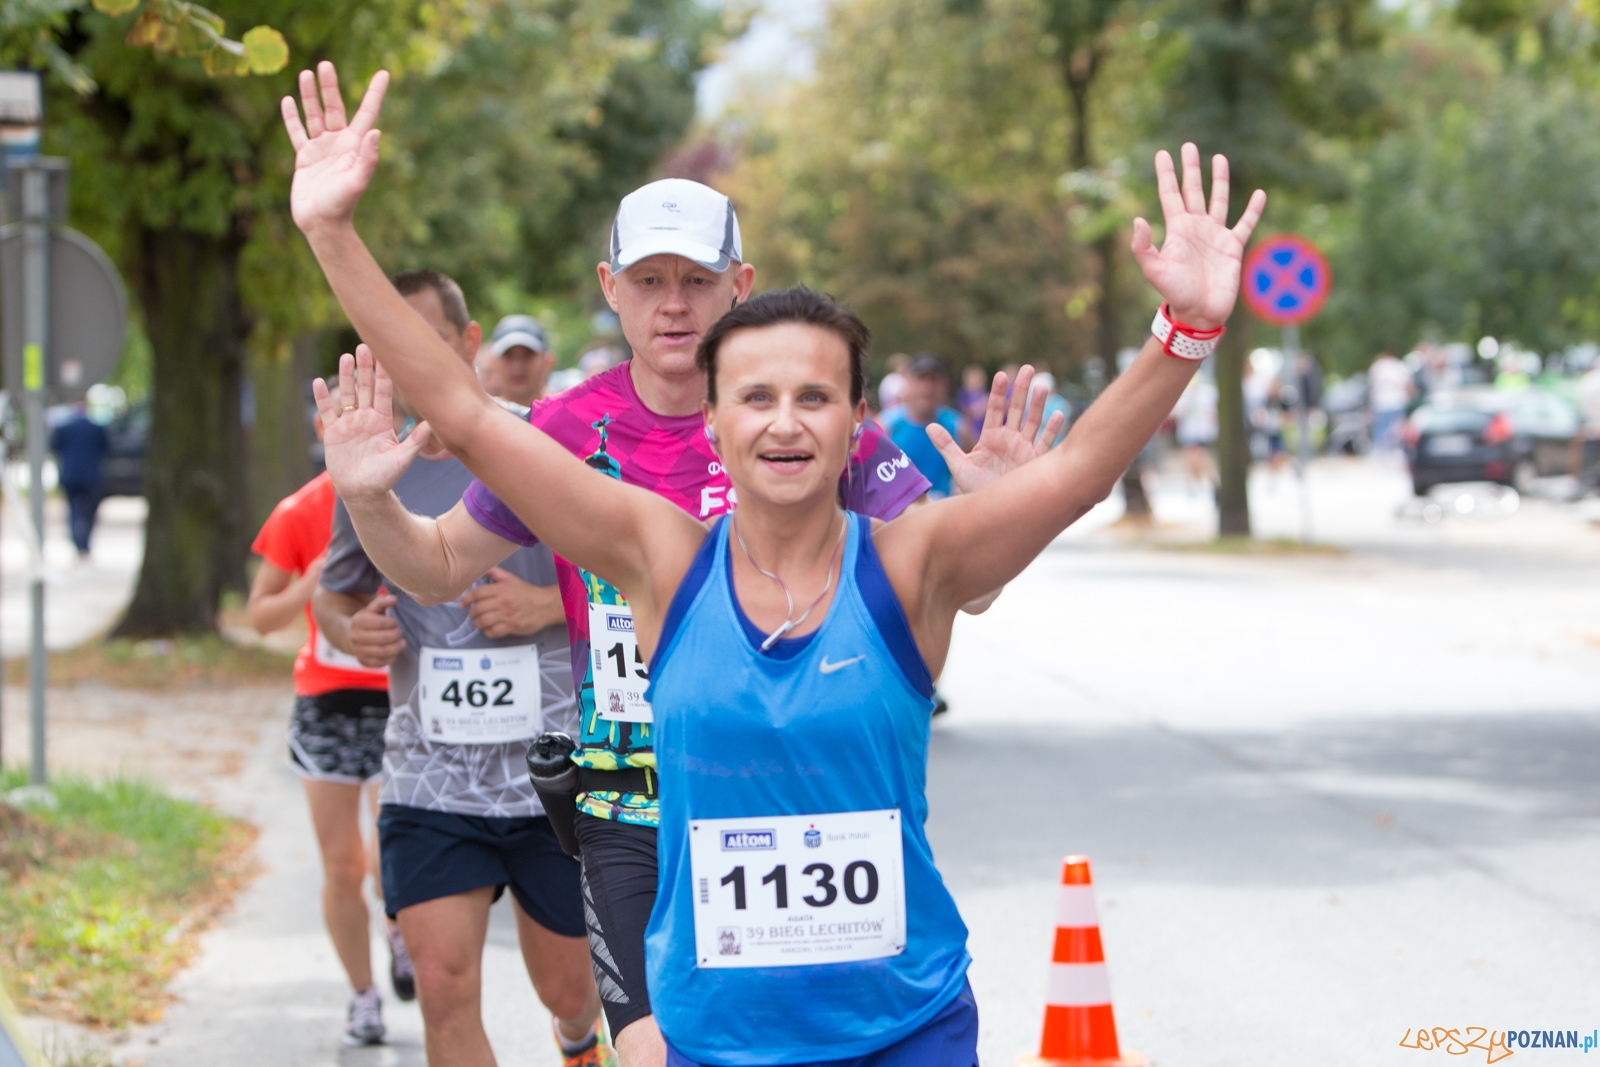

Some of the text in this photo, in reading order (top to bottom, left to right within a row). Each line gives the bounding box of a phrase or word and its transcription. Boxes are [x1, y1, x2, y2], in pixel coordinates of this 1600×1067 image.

[441, 677, 514, 708] 462
[627, 691, 640, 702] 39
[720, 860, 880, 911] 1130
[745, 918, 885, 939] 39 BIEG LECHITÓW
